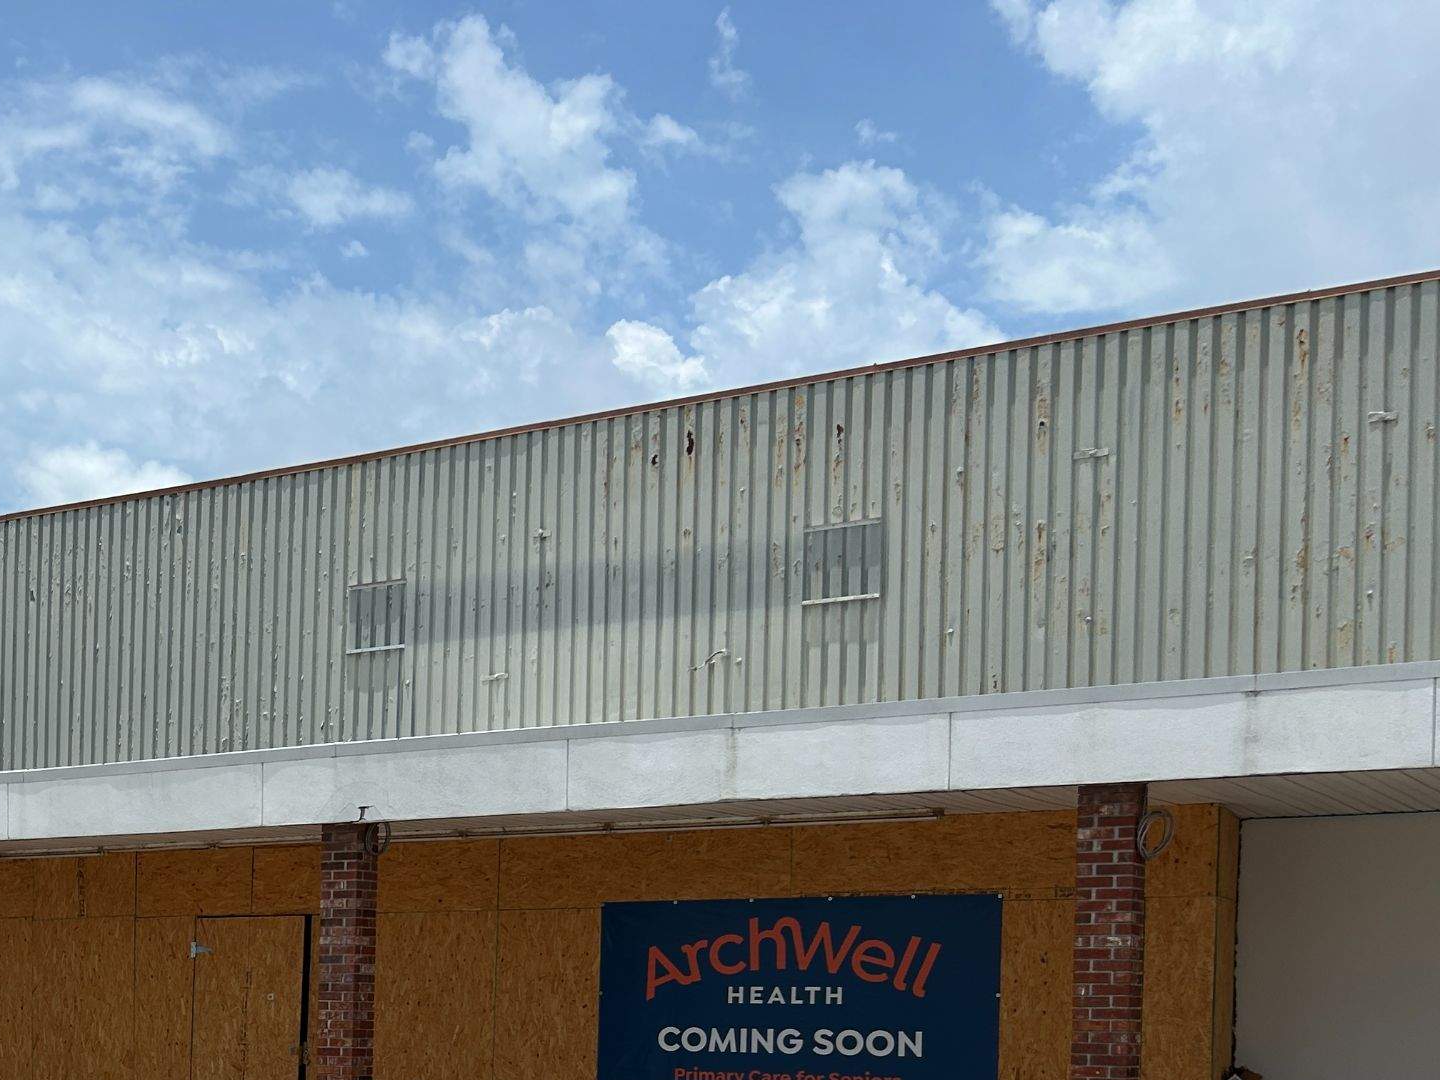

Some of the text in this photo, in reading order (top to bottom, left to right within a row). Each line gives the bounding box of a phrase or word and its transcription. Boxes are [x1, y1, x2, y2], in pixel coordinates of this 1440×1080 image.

[645, 915, 942, 1001] ArchWell
[727, 986, 843, 1005] HEALTH
[658, 1026, 923, 1058] COMING SOON
